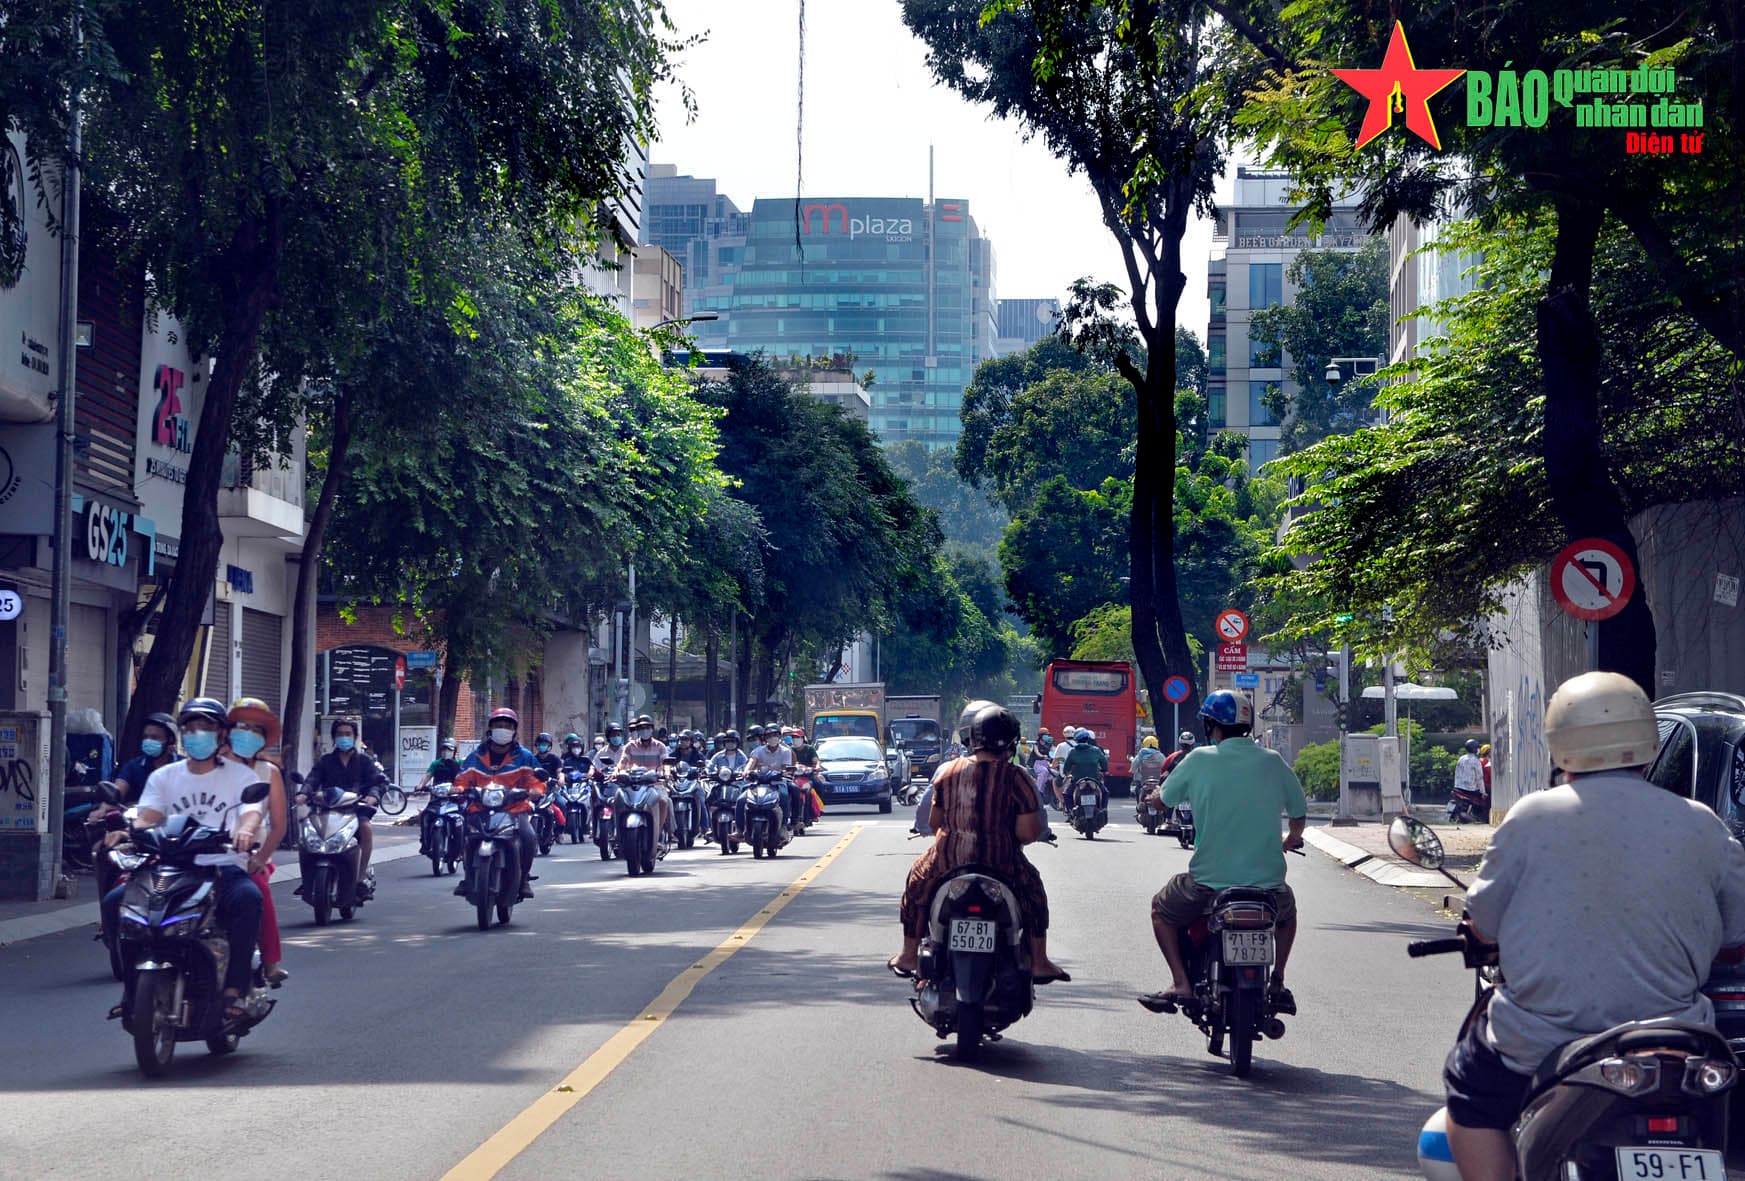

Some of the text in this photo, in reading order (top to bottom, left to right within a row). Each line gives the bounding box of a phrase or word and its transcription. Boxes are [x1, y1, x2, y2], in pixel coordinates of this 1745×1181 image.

[851, 214, 913, 241] plaza
[87, 500, 128, 568] GS25
[172, 792, 227, 815] ADIDAS
[957, 921, 988, 936] 67-B1
[1231, 947, 1267, 961] 7873
[1633, 1152, 1707, 1181] 59-F1
